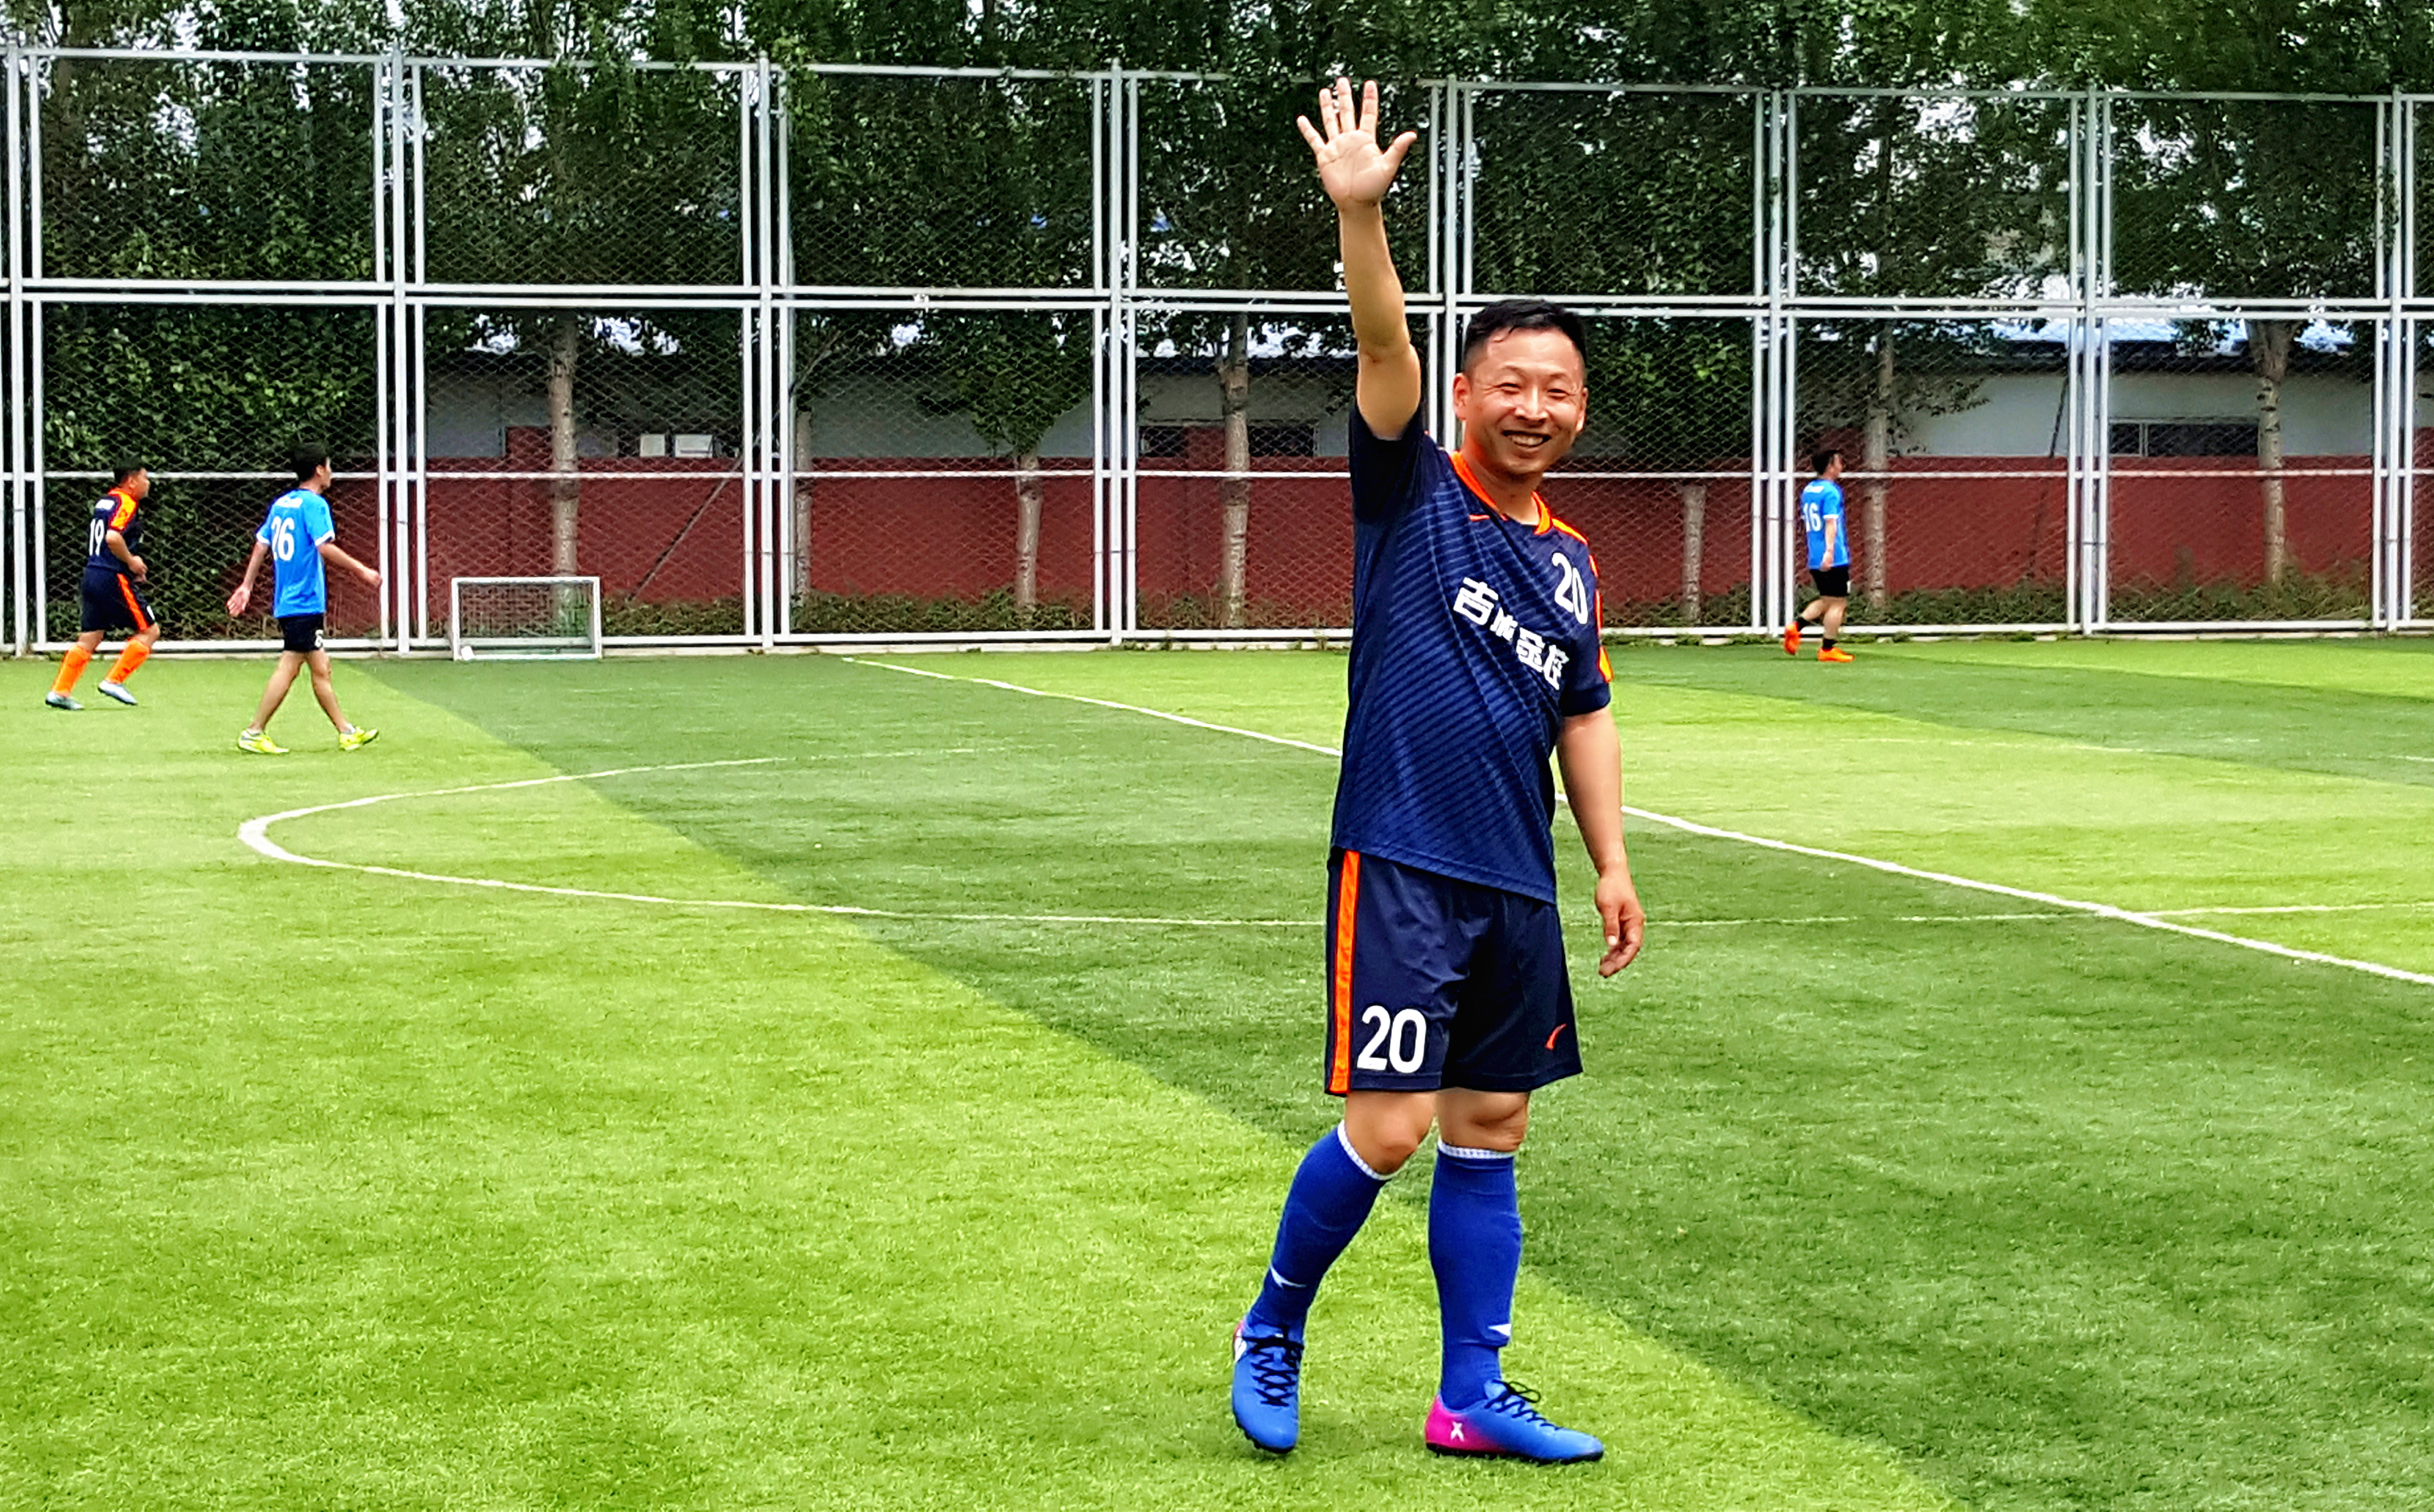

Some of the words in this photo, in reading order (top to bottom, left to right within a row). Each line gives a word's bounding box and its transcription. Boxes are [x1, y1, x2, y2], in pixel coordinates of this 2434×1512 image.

[89, 518, 105, 556] 19
[271, 516, 295, 561] 26
[1803, 502, 1821, 532] 16
[1552, 553, 1588, 624] 20
[1357, 1005, 1427, 1073] 20
